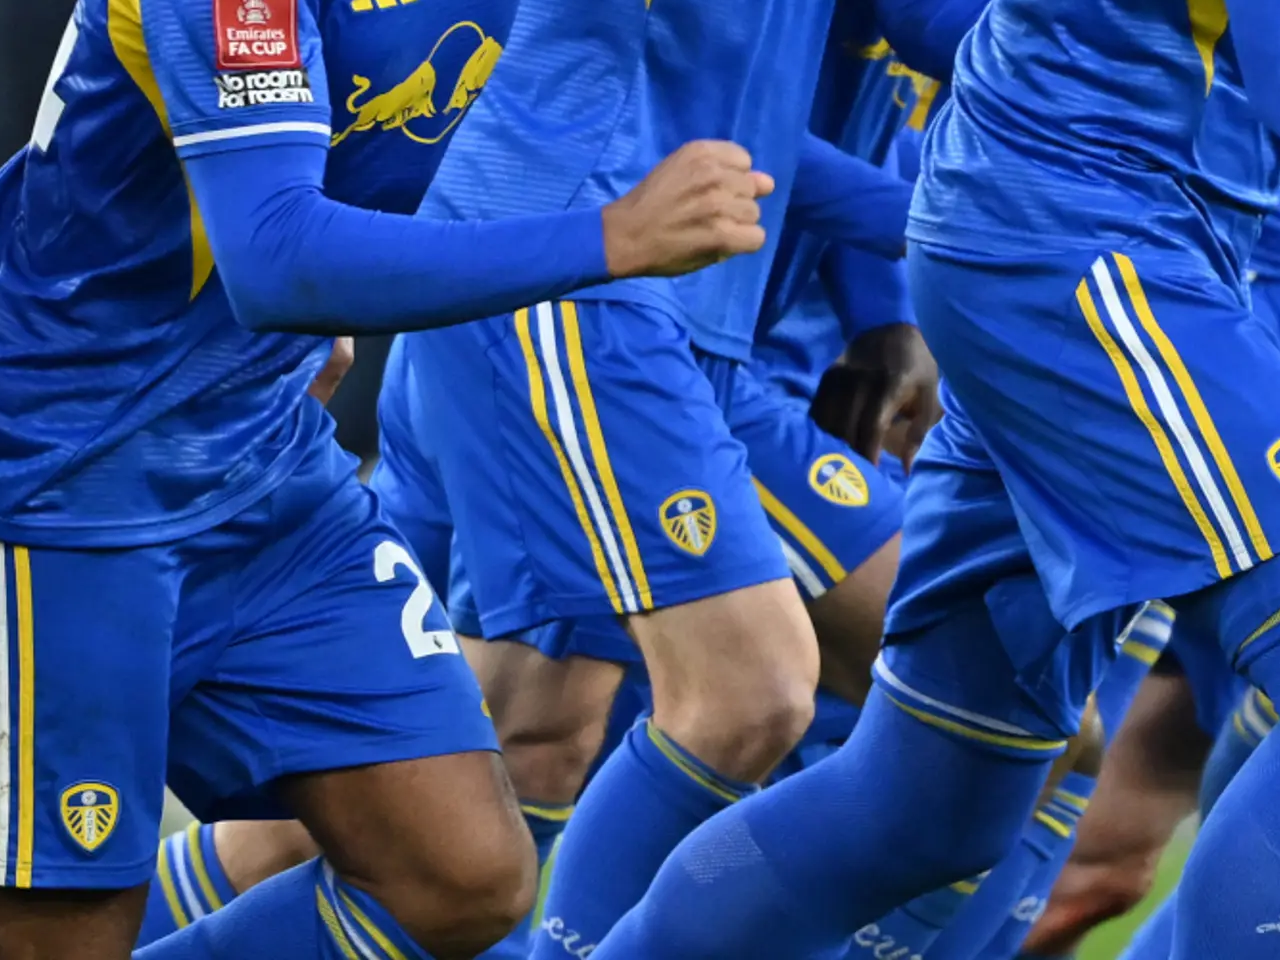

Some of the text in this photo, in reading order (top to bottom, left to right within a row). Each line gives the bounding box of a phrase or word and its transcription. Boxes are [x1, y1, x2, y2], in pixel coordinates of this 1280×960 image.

[226, 27, 285, 41] Emirates
[229, 41, 287, 56] FA CUP
[245, 70, 303, 89] room
[218, 88, 314, 108] for racism
[373, 540, 460, 659] 2
